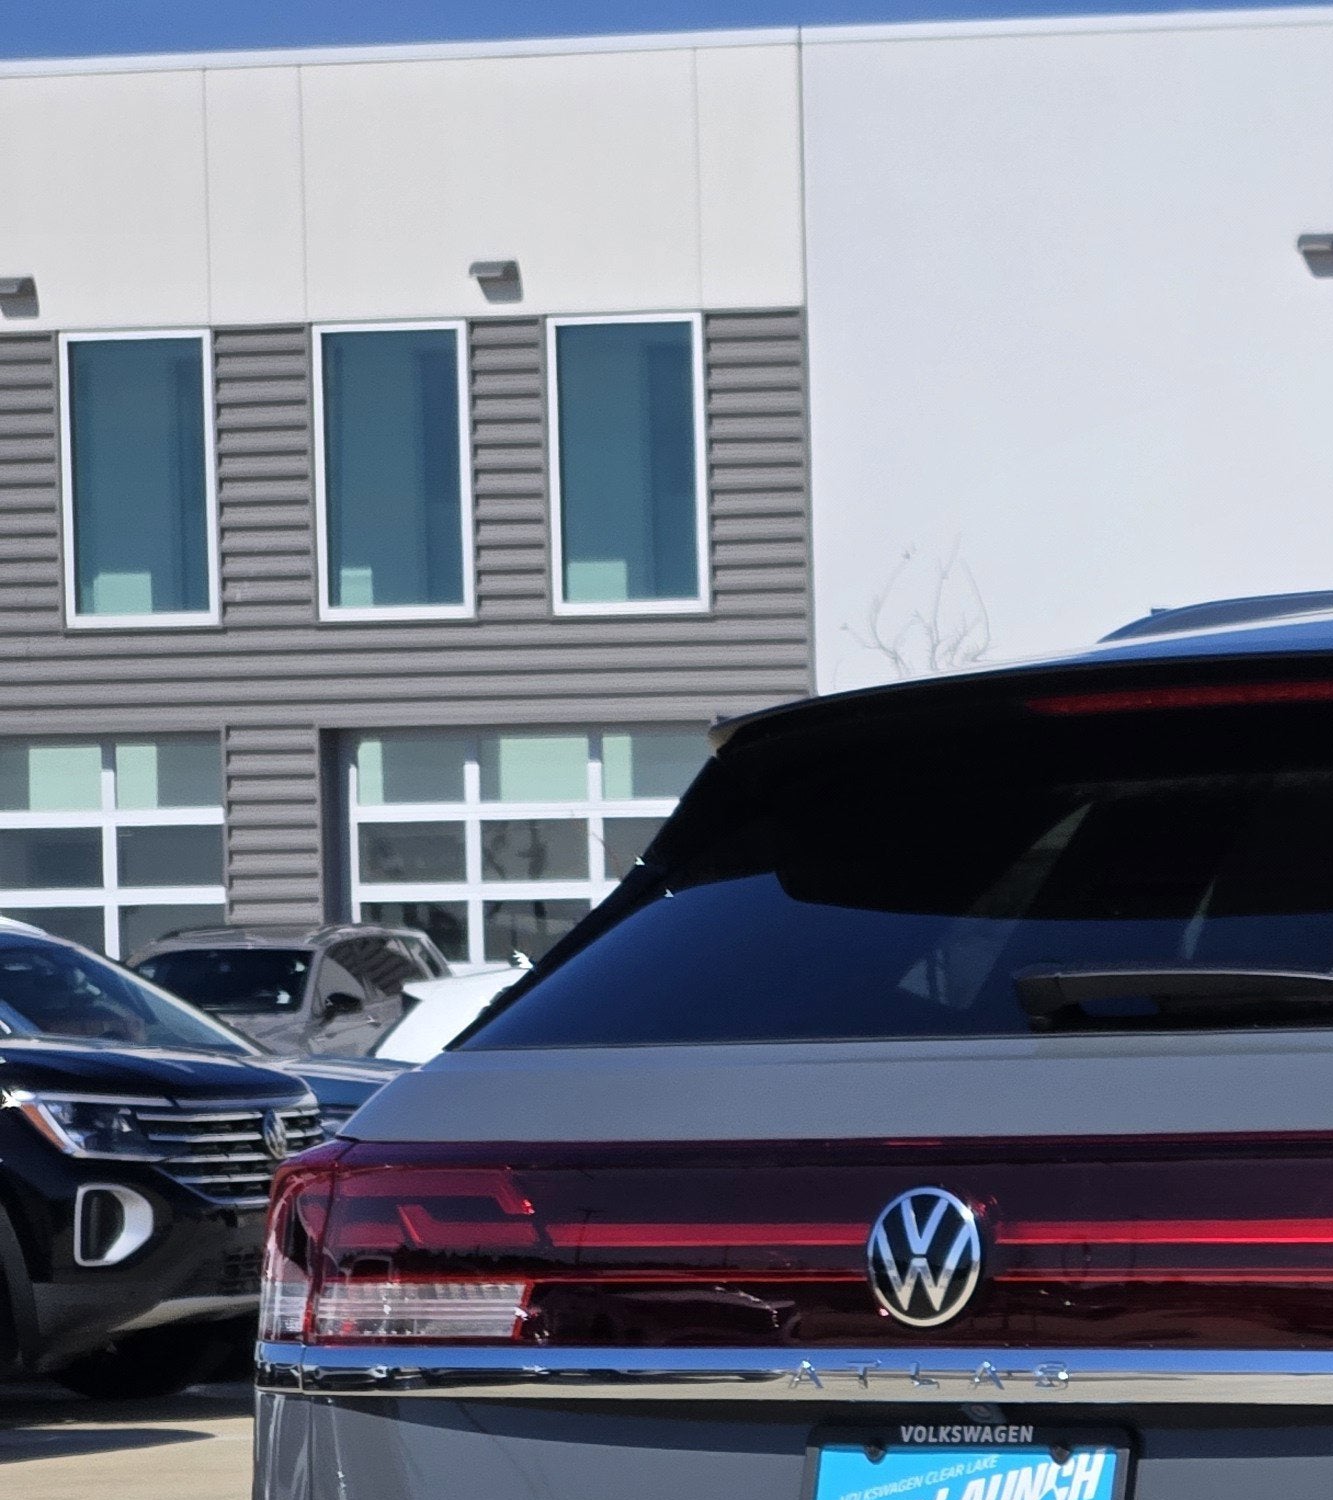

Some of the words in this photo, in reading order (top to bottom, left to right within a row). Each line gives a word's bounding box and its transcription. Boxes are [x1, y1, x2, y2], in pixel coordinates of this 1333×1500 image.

[870, 1190, 979, 1323] VW
[788, 1360, 1069, 1391] ATLAS
[900, 1425, 1033, 1443] VOLKSWAGEN
[924, 1463, 966, 1489] CLEAR
[966, 1455, 999, 1475] LAKE
